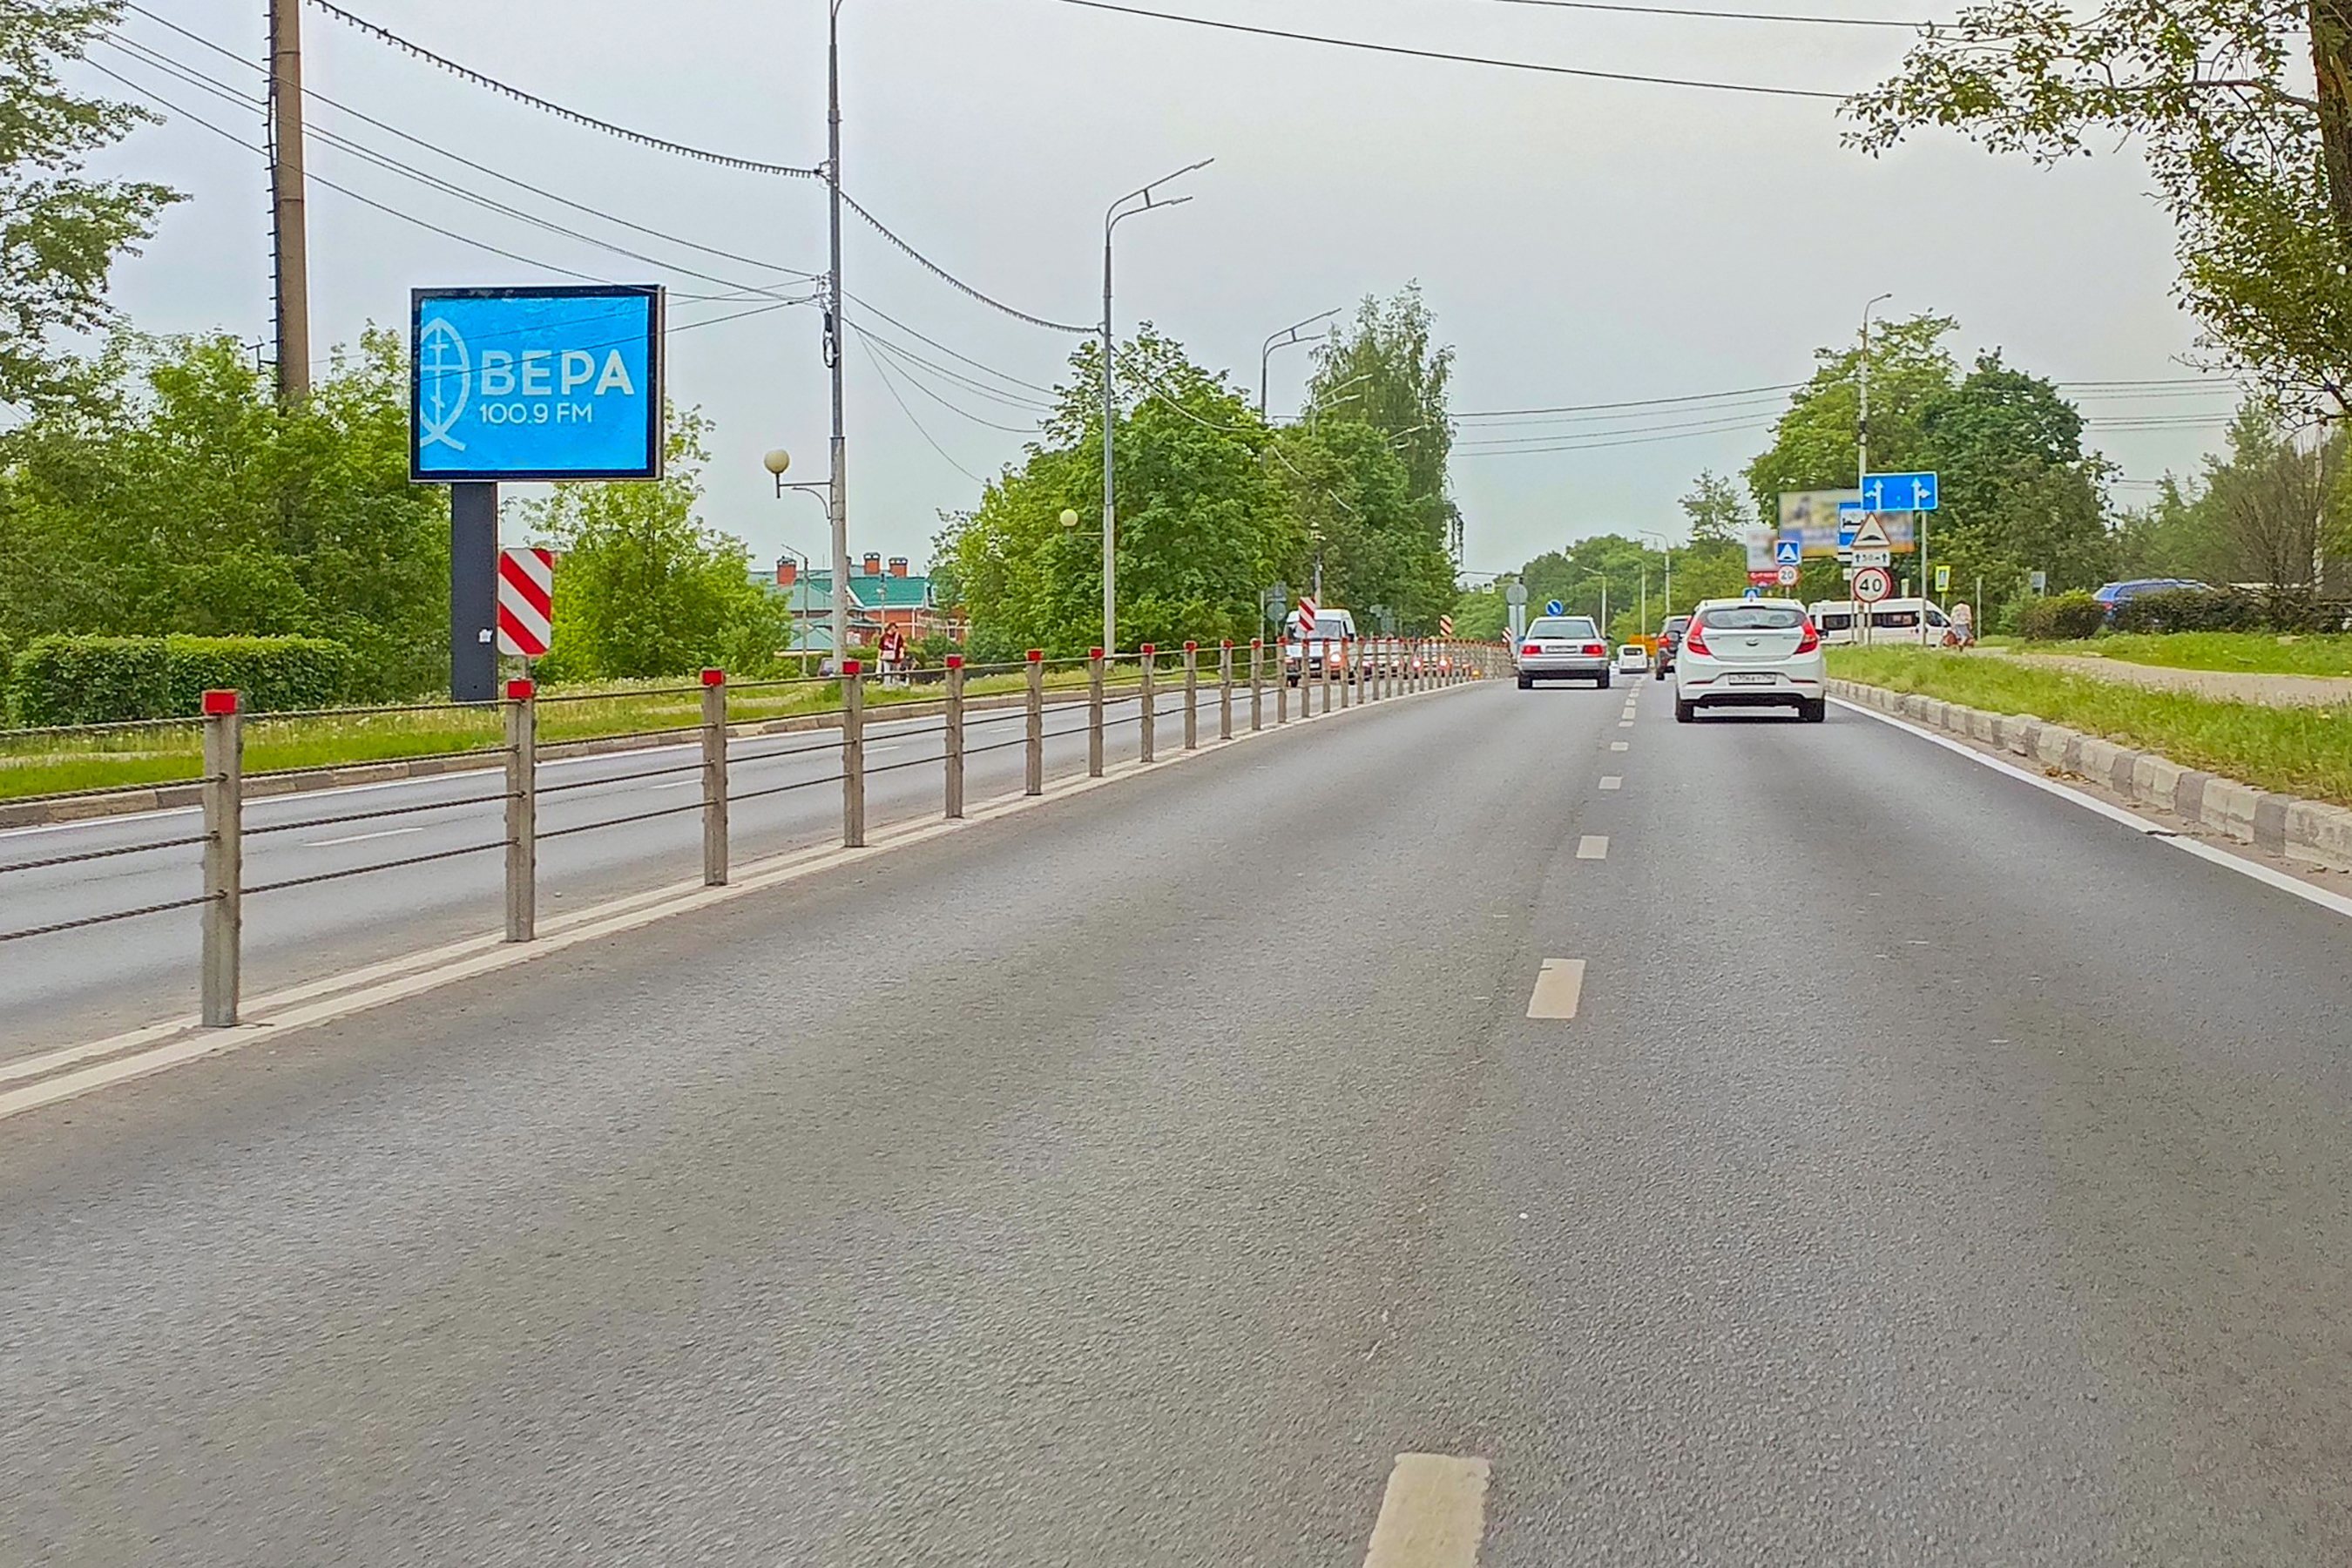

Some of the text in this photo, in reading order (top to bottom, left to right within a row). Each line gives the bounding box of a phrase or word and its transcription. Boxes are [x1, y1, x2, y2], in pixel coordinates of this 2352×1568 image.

[481, 349, 634, 395] ВЕРА
[479, 402, 592, 423] 100.9 FM
[1781, 570, 1794, 580] 20
[1859, 578, 1882, 592] 40
